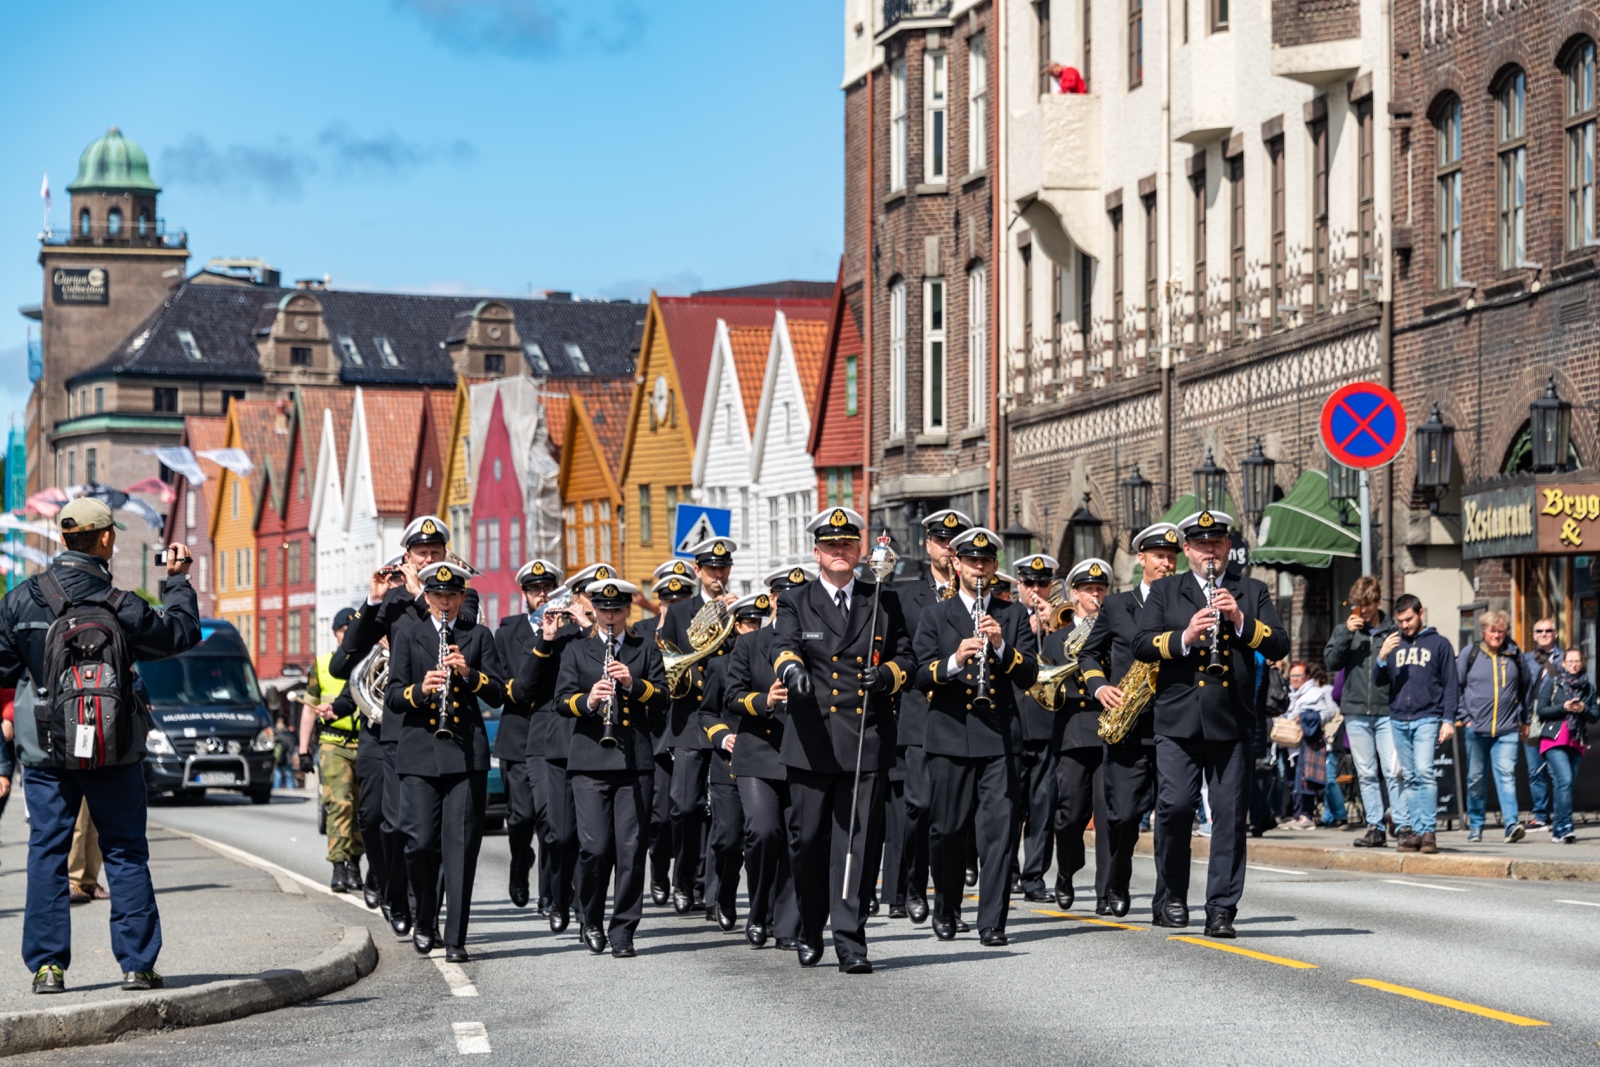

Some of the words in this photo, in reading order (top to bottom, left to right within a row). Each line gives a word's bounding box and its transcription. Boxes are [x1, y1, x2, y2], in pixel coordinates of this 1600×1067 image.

[54, 269, 88, 286] Clarion
[1463, 497, 1533, 543] Restaurant
[1560, 517, 1583, 546] &
[1395, 646, 1432, 668] GAP
[162, 711, 202, 723] MUSEUM
[202, 711, 236, 720] SHUTTLE
[236, 712, 256, 722] BUS
